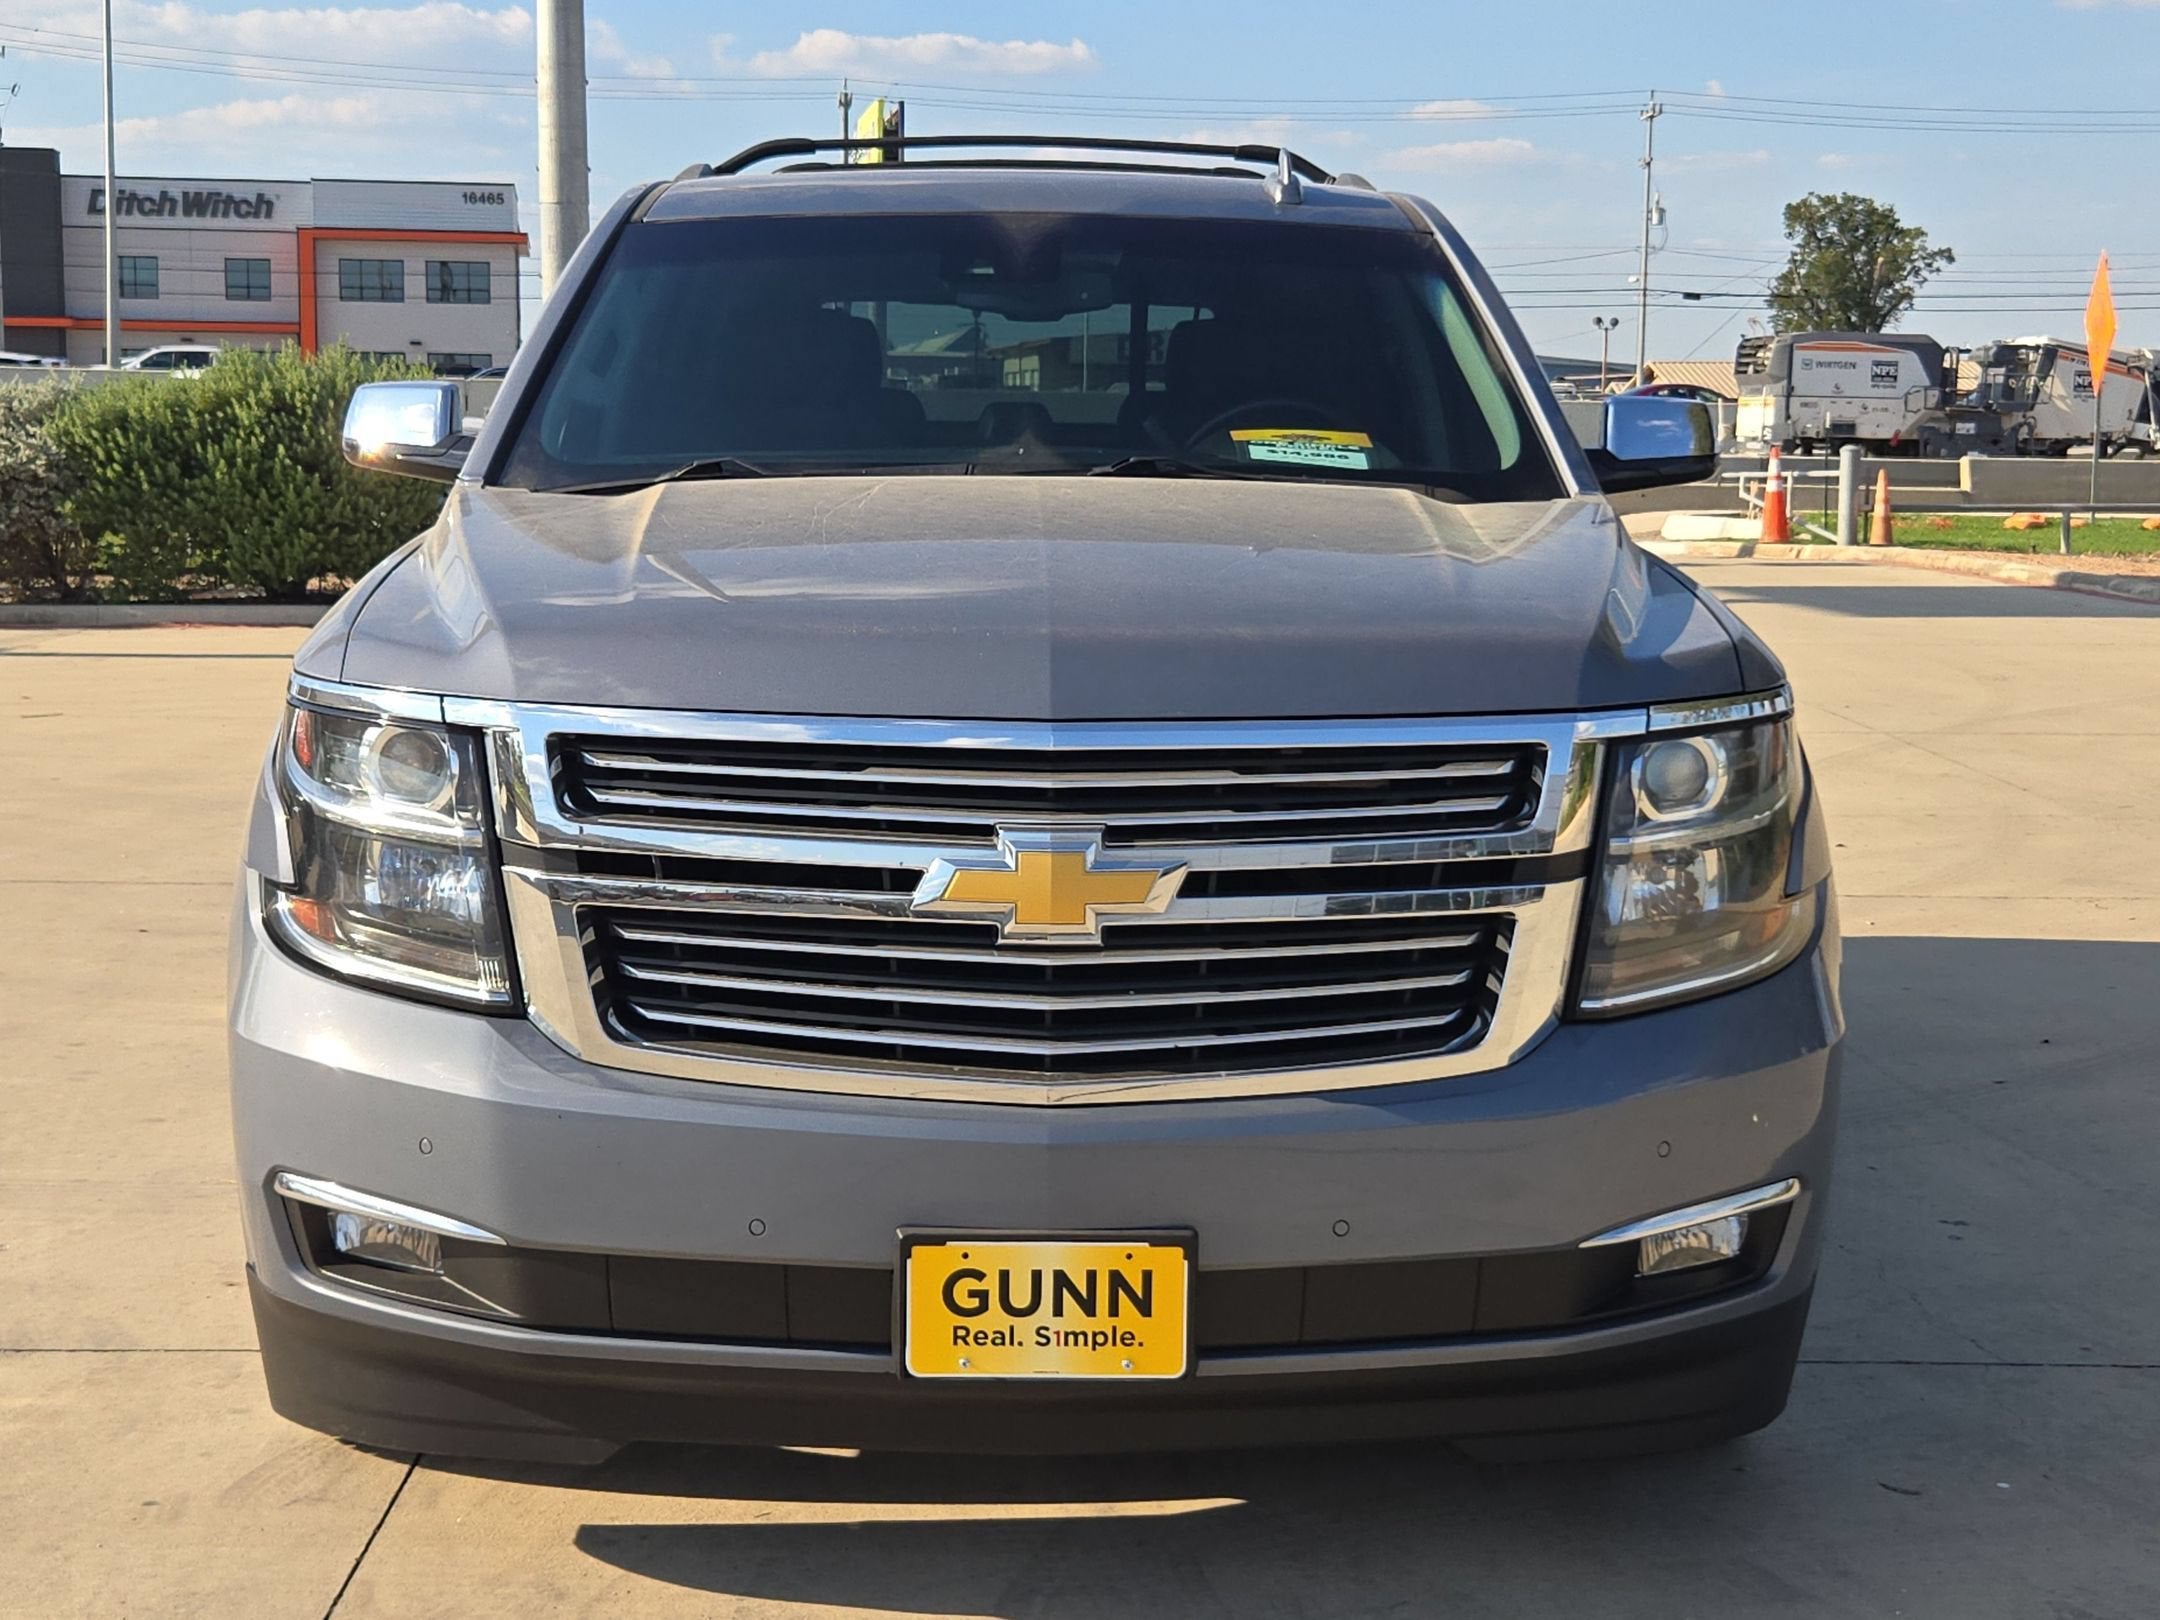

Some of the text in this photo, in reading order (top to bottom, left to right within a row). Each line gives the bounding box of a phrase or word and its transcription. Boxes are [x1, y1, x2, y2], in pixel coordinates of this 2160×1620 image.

[87, 189, 275, 220] Ditch Witch
[462, 191, 505, 206] 16465
[1815, 360, 1857, 370] WIRTGEN
[1871, 365, 1898, 377] NPE
[941, 1267, 1153, 1318] GUNN
[952, 1325, 1024, 1348] Real.
